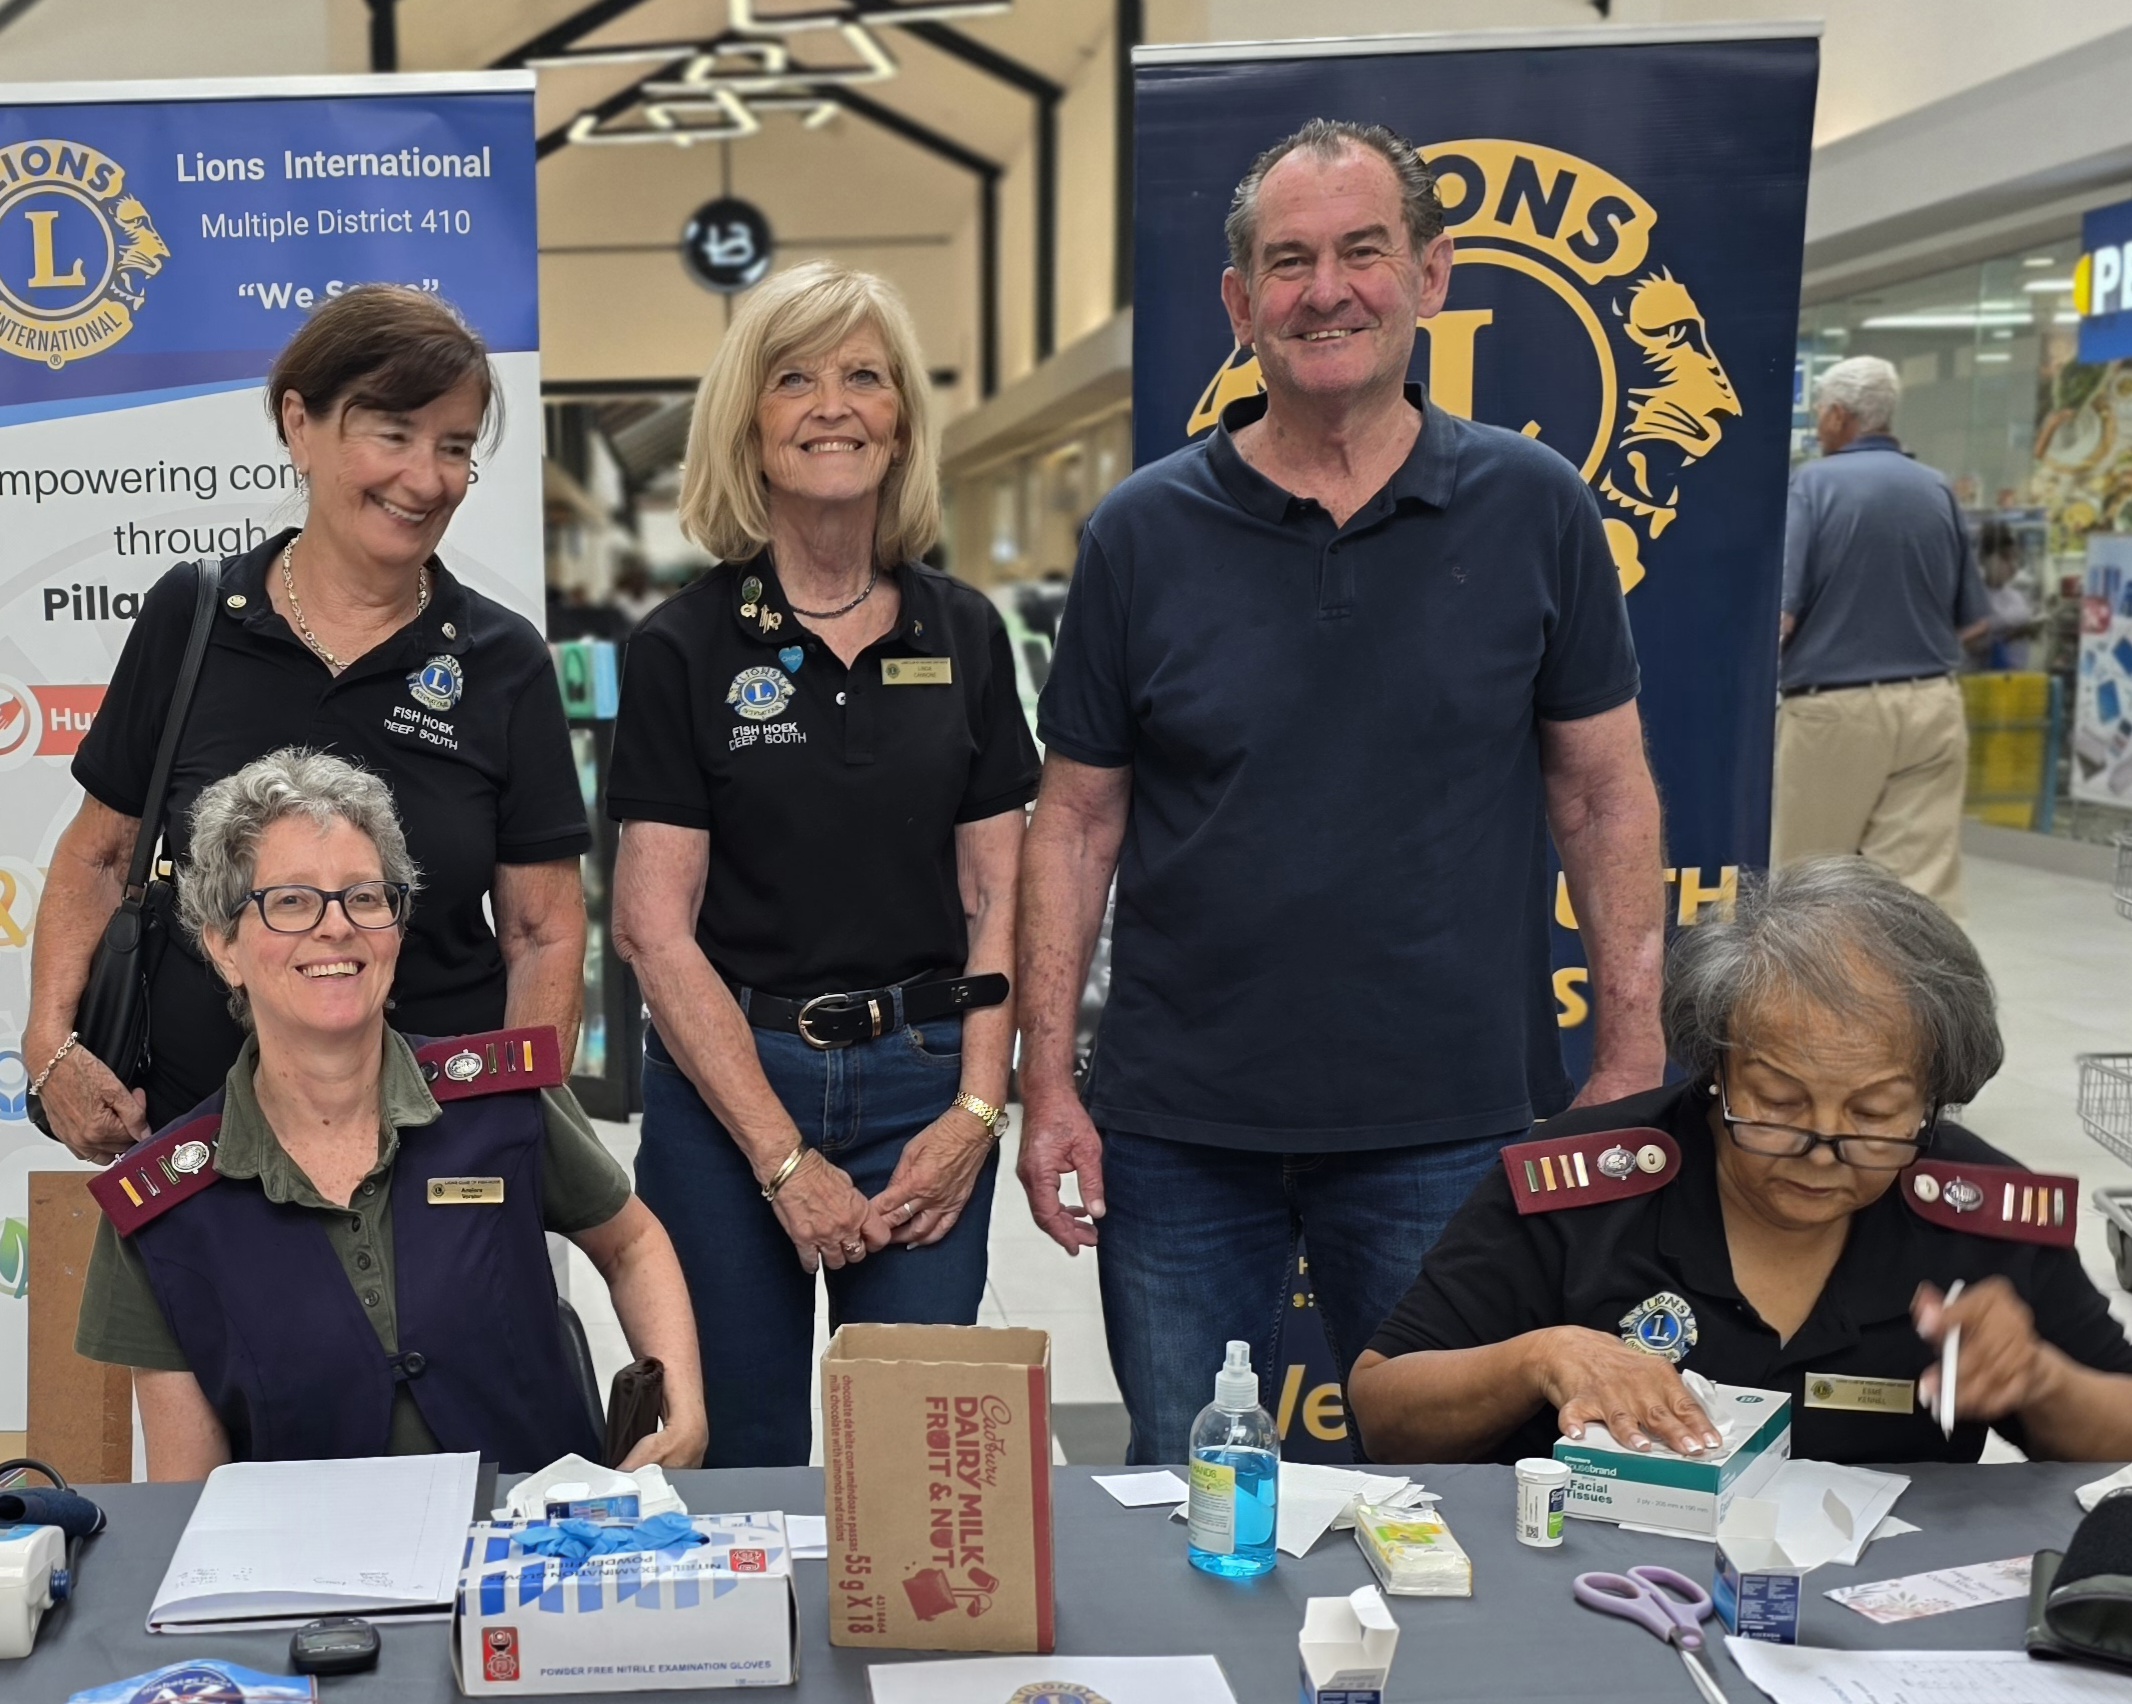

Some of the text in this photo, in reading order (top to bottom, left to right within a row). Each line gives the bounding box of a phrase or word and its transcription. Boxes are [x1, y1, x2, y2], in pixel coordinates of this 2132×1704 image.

[0, 145, 115, 193] IONS
[177, 146, 491, 182] Lions International
[201, 208, 471, 243] Multiple District 410
[44, 583, 147, 621] Pilla
[393, 706, 454, 736] FISH HOEK
[732, 721, 798, 739] FISH HOEK
[419, 728, 458, 751] SOUTH
[764, 732, 807, 744] SOUTH
[1647, 1295, 1688, 1314] LIONS
[980, 1394, 1012, 1488] Cadbury
[829, 1375, 846, 1542] milk chocolate with almonds and raisins
[926, 1396, 955, 1569] FRUIT & NUT
[954, 1396, 985, 1567] DAIRY MILK
[1570, 1479, 1608, 1494] Facial
[1564, 1488, 1613, 1504] Tissues
[546, 1556, 653, 1570] POWDER FREE
[550, 1565, 660, 1579] EXAMINATION
[847, 1554, 872, 1576] 55
[838, 1579, 864, 1591] g
[847, 1613, 875, 1635] 18
[540, 1660, 772, 1676] POWDER FREE NITRILE EXAMINATION GLOVES
